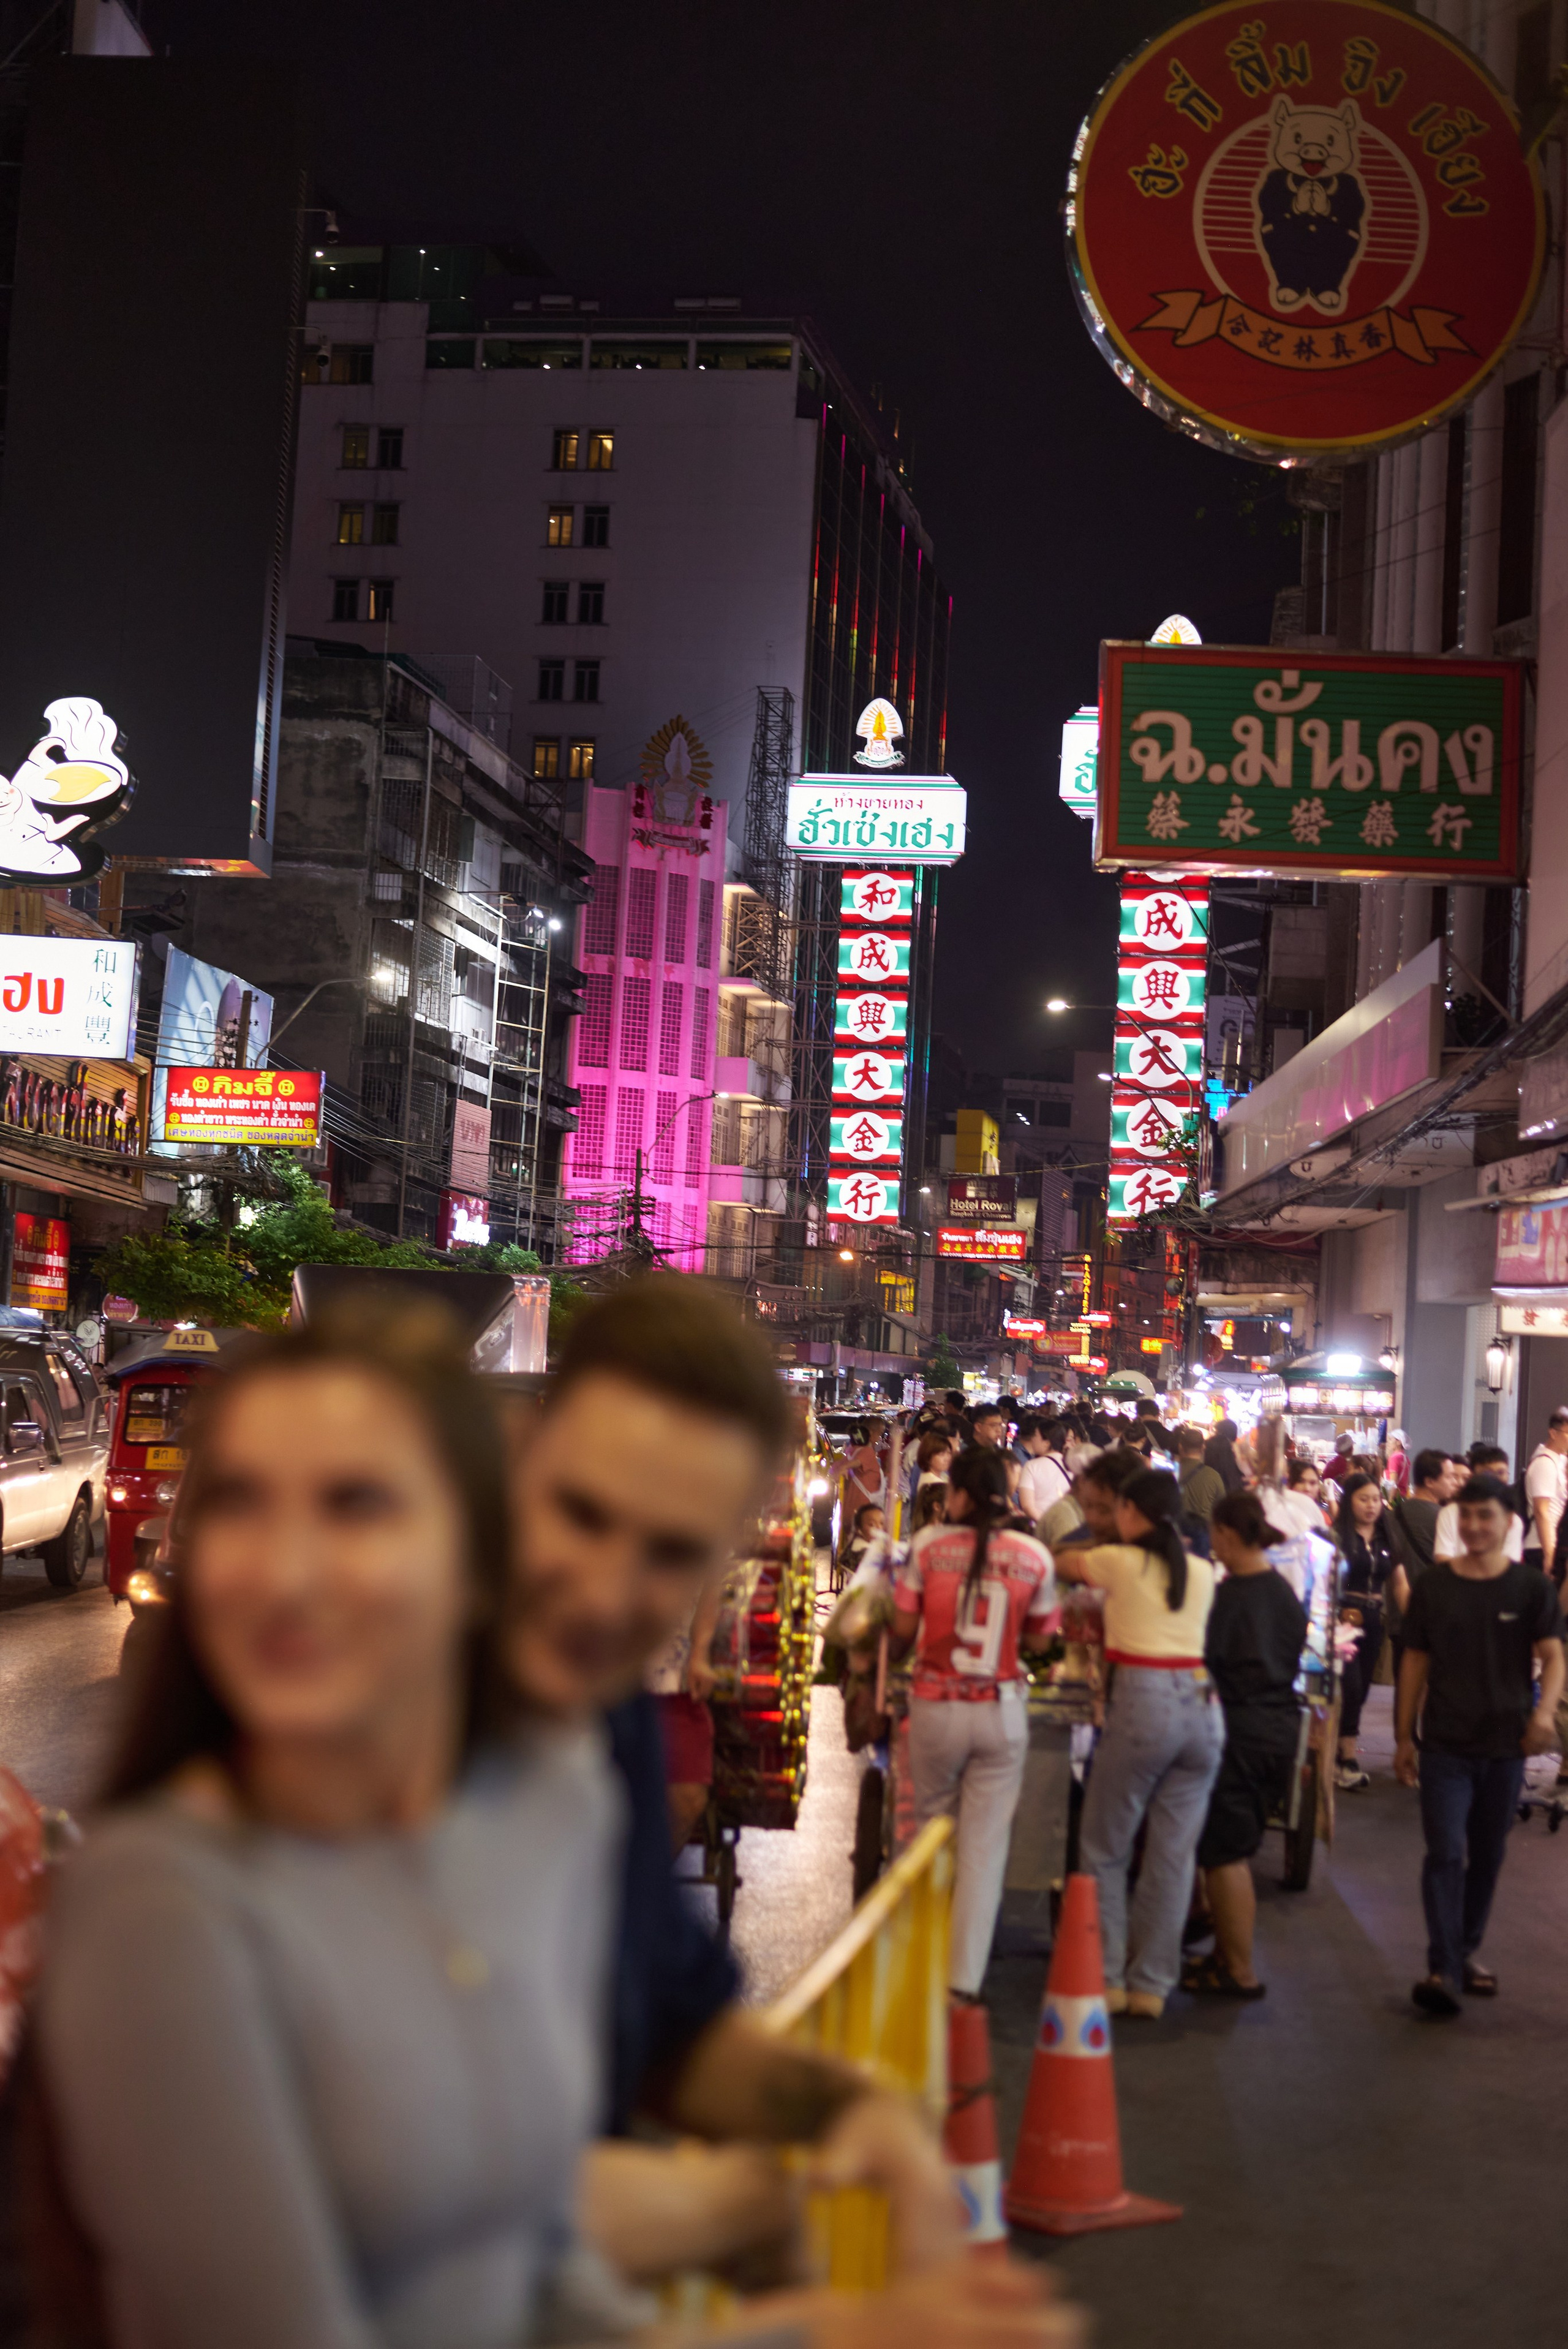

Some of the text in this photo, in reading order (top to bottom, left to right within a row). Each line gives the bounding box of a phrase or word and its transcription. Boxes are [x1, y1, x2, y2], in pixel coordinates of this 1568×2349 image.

[950, 1198, 979, 1210] Hotel
[174, 1333, 206, 1346] TAXI
[950, 1578, 1009, 1676] 9
